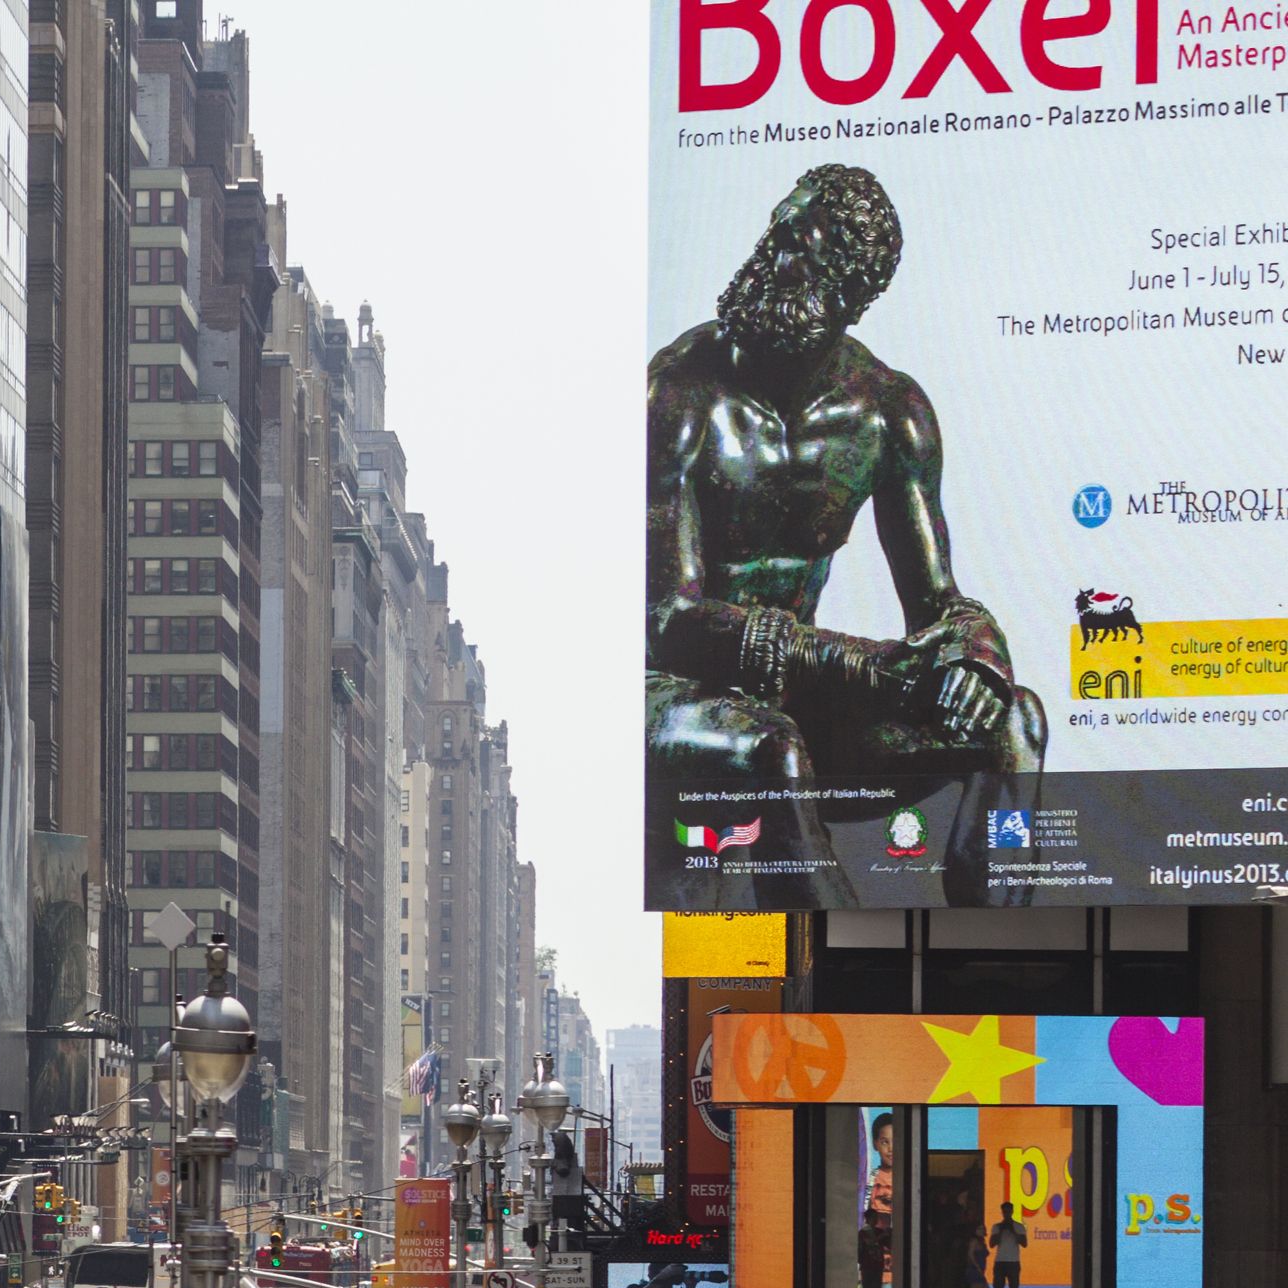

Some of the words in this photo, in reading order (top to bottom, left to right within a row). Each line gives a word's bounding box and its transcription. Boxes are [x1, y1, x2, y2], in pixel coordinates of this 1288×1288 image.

[1176, 10, 1212, 36] An
[678, 127, 724, 148] from
[729, 124, 759, 145] the
[764, 121, 832, 143] Museo
[836, 114, 939, 140] Nazionale
[945, 110, 1032, 134] Romano
[1047, 103, 1130, 127] Palazzo
[1134, 97, 1230, 123] Massimo
[1234, 92, 1272, 117] alle
[1151, 225, 1226, 254] Special
[1129, 269, 1176, 290] June
[1210, 265, 1251, 290] July
[1258, 262, 1285, 289] 15,
[997, 315, 1035, 336] The
[1043, 309, 1176, 337] Metropolitan
[1183, 306, 1273, 328] Museum
[1238, 344, 1285, 365] New
[1160, 481, 1186, 494] THE
[1178, 509, 1243, 524] MUSEUM
[1250, 507, 1268, 522] OF
[1170, 638, 1223, 654] culture
[1226, 637, 1243, 653] of
[1170, 663, 1222, 679] energy
[1225, 658, 1242, 674] of
[1079, 656, 1142, 700] eni
[1069, 709, 1097, 730] eni,
[1100, 713, 1110, 725] a
[1115, 708, 1197, 724] worldwide
[1202, 709, 1257, 727] energy
[720, 791, 757, 802] Auspices
[783, 789, 822, 800] President
[860, 788, 896, 799] Republic
[685, 857, 719, 869] 2013
[1053, 861, 1087, 872] Speciale
[1088, 875, 1113, 885] Roma
[404, 1189, 446, 1200] SOLSTICE
[1125, 1193, 1201, 1236] p.s.
[1034, 1227, 1058, 1240] from
[399, 1238, 421, 1247] MIND
[424, 1238, 445, 1247] OVER
[399, 1248, 445, 1257] MADNESS
[400, 1258, 445, 1273] YOGA
